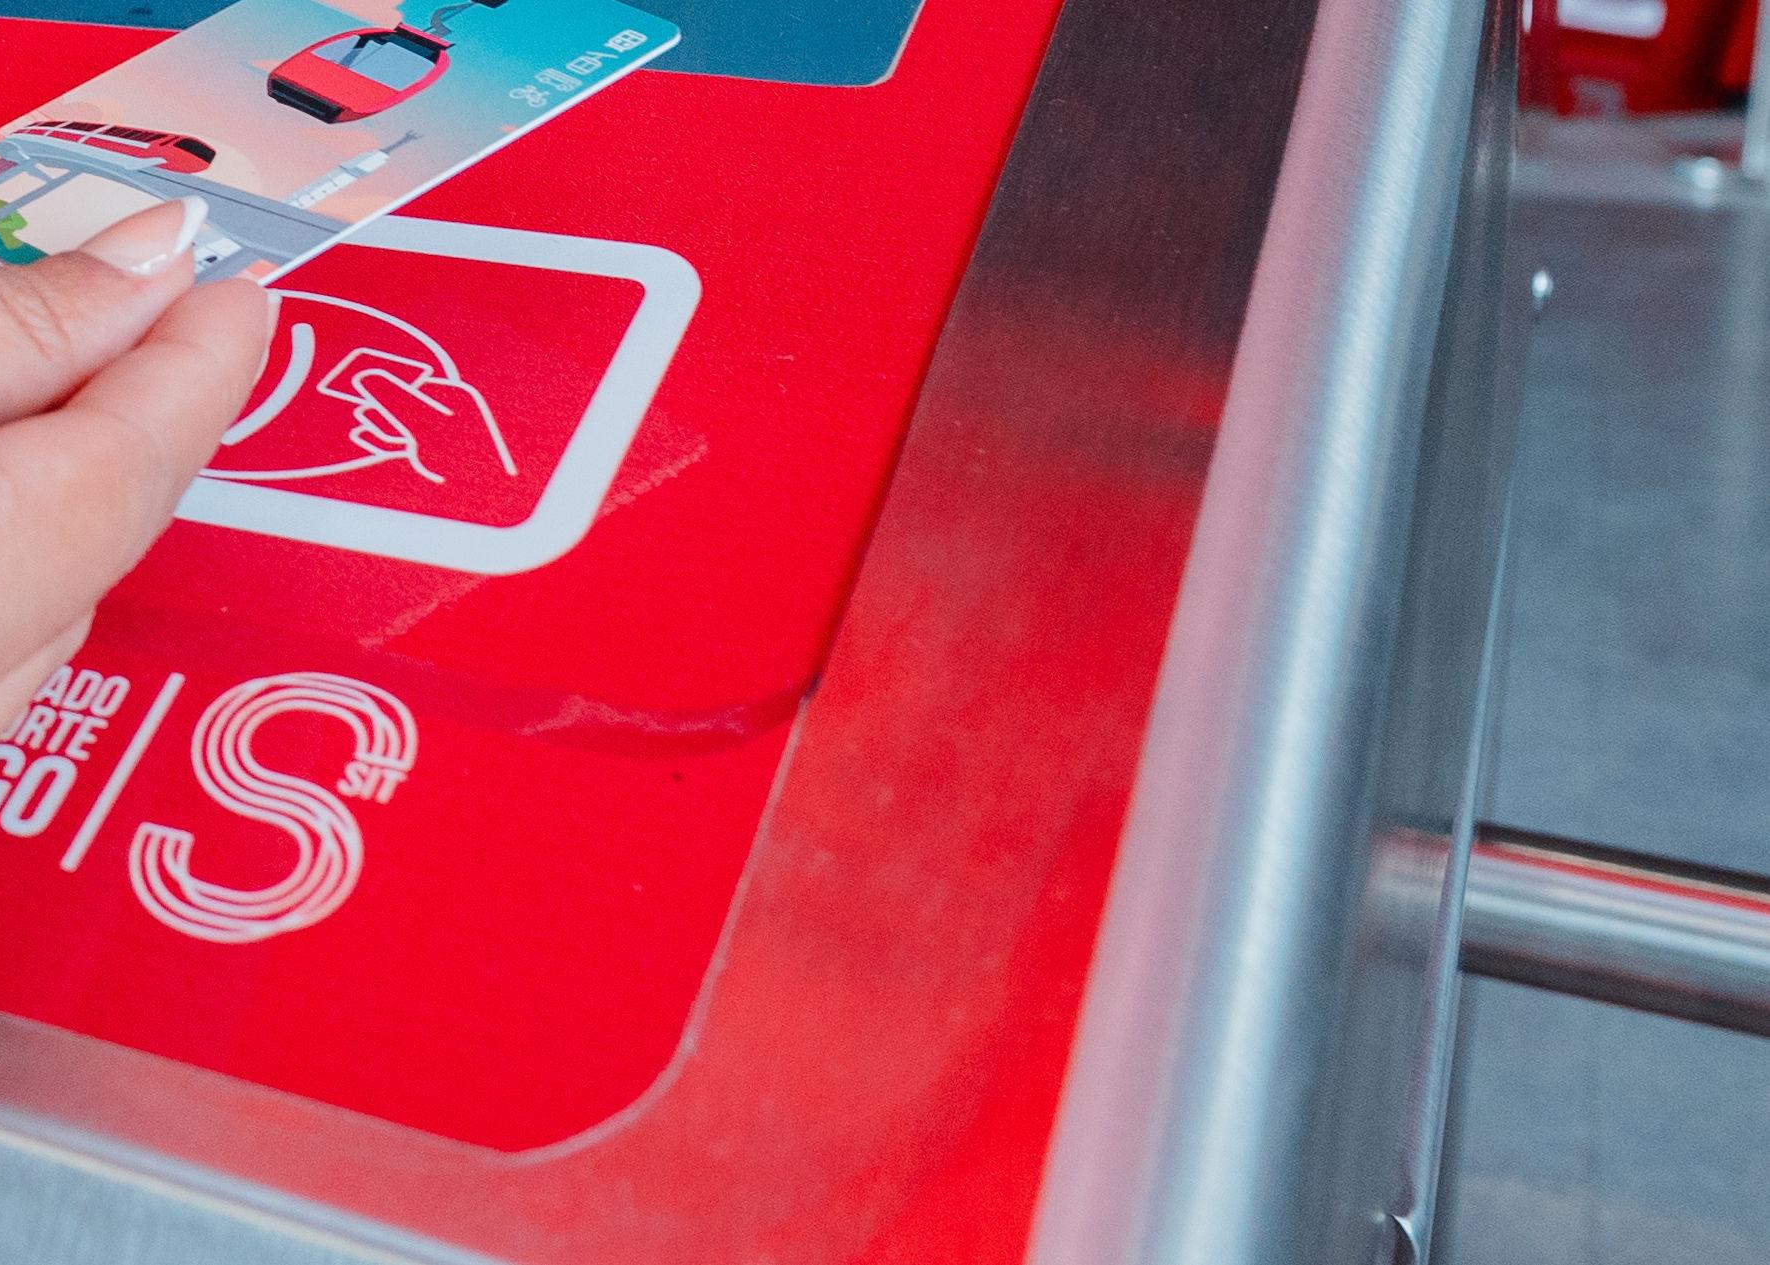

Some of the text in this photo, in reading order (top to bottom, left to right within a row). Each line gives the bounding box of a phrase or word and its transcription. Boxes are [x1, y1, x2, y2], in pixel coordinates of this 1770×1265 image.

[33, 664, 131, 718] ADO
[130, 672, 418, 943] S
[336, 762, 408, 806] SIT
